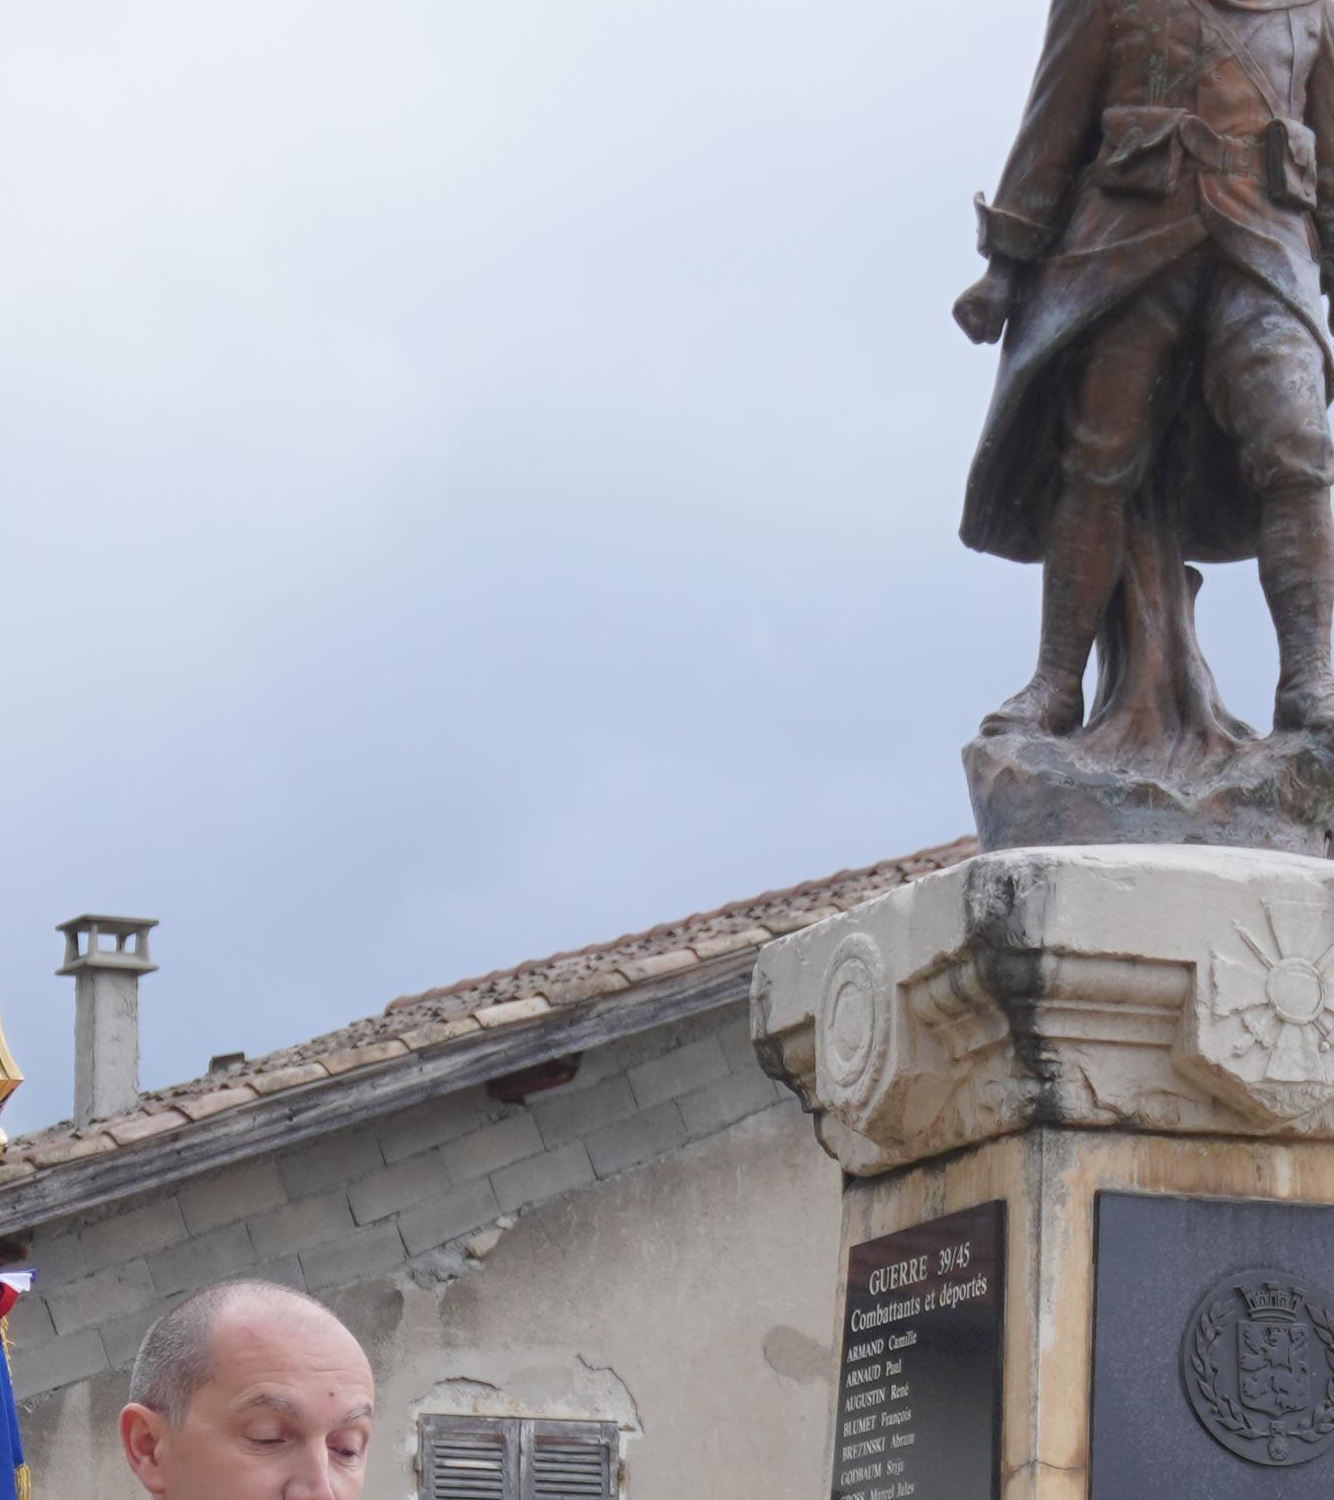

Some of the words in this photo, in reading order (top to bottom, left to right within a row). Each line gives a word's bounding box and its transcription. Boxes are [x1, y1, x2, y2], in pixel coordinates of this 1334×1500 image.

[869, 1255, 928, 1295] GUERRE
[937, 1241, 971, 1275] 39/45
[851, 1297, 920, 1332] Combattants
[924, 1291, 935, 1311] et
[939, 1273, 987, 1308] déportés
[847, 1338, 884, 1363] ARMAND
[888, 1330, 917, 1351] Camille
[846, 1364, 881, 1388] ARNAUD
[886, 1358, 902, 1376] Paul
[845, 1387, 886, 1412] AUGUSTIN
[890, 1381, 909, 1400] René
[843, 1415, 876, 1437] BLUMET
[881, 1406, 912, 1427] François
[896, 1481, 915, 1498] Jules
